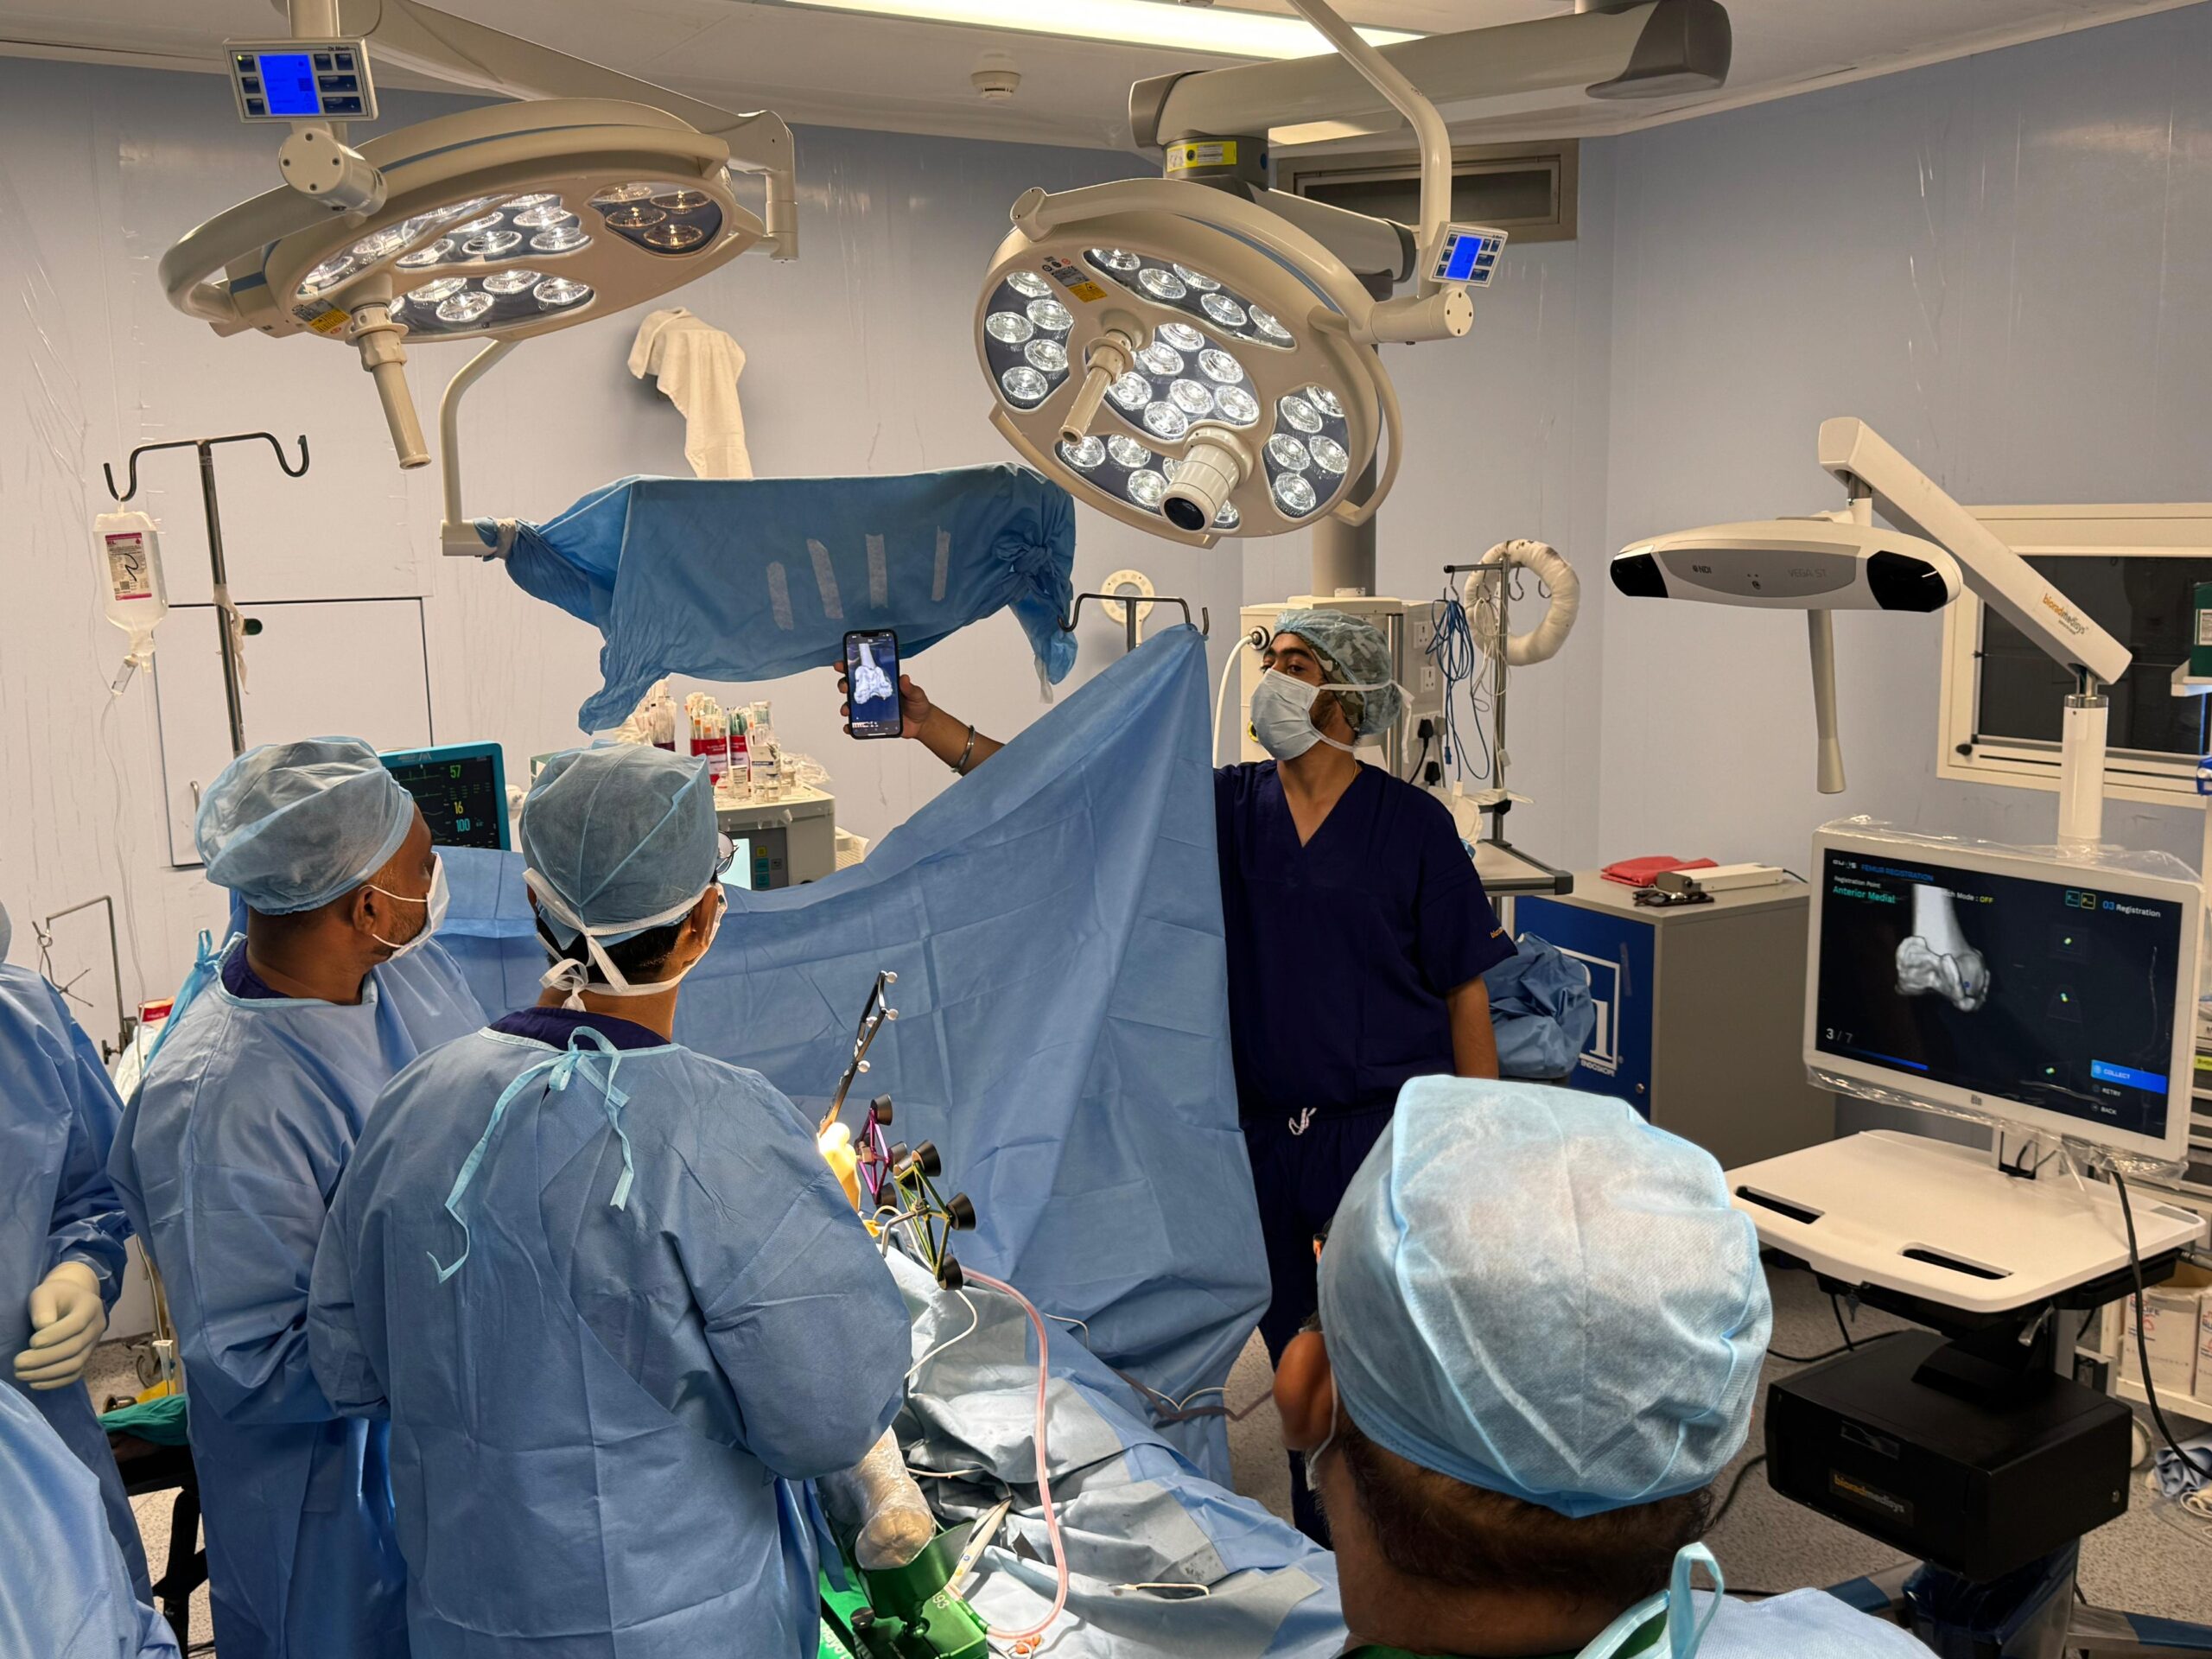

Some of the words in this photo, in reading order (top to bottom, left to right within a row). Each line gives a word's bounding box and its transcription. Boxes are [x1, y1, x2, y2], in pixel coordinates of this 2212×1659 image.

[1699, 565, 1713, 575] NDI
[1788, 568, 1812, 578] VEGA
[450, 764, 461, 779] 57
[454, 801, 464, 815] 16
[455, 817, 471, 832] 100
[1834, 874, 1866, 887] Registration
[1885, 868, 1935, 882] REGISTRATION
[1832, 885, 1866, 899] Anterior
[1867, 892, 1897, 905] Medial
[1956, 893, 1975, 902] Mode
[2102, 900, 2115, 911] 03
[2115, 904, 2161, 918] Registration
[1826, 1027, 1834, 1040] 3
[1845, 1033, 1853, 1044] 7
[2103, 1068, 2131, 1079] COLLECT
[2101, 1087, 2122, 1097] RETRY
[2100, 1106, 2118, 1116] BACK
